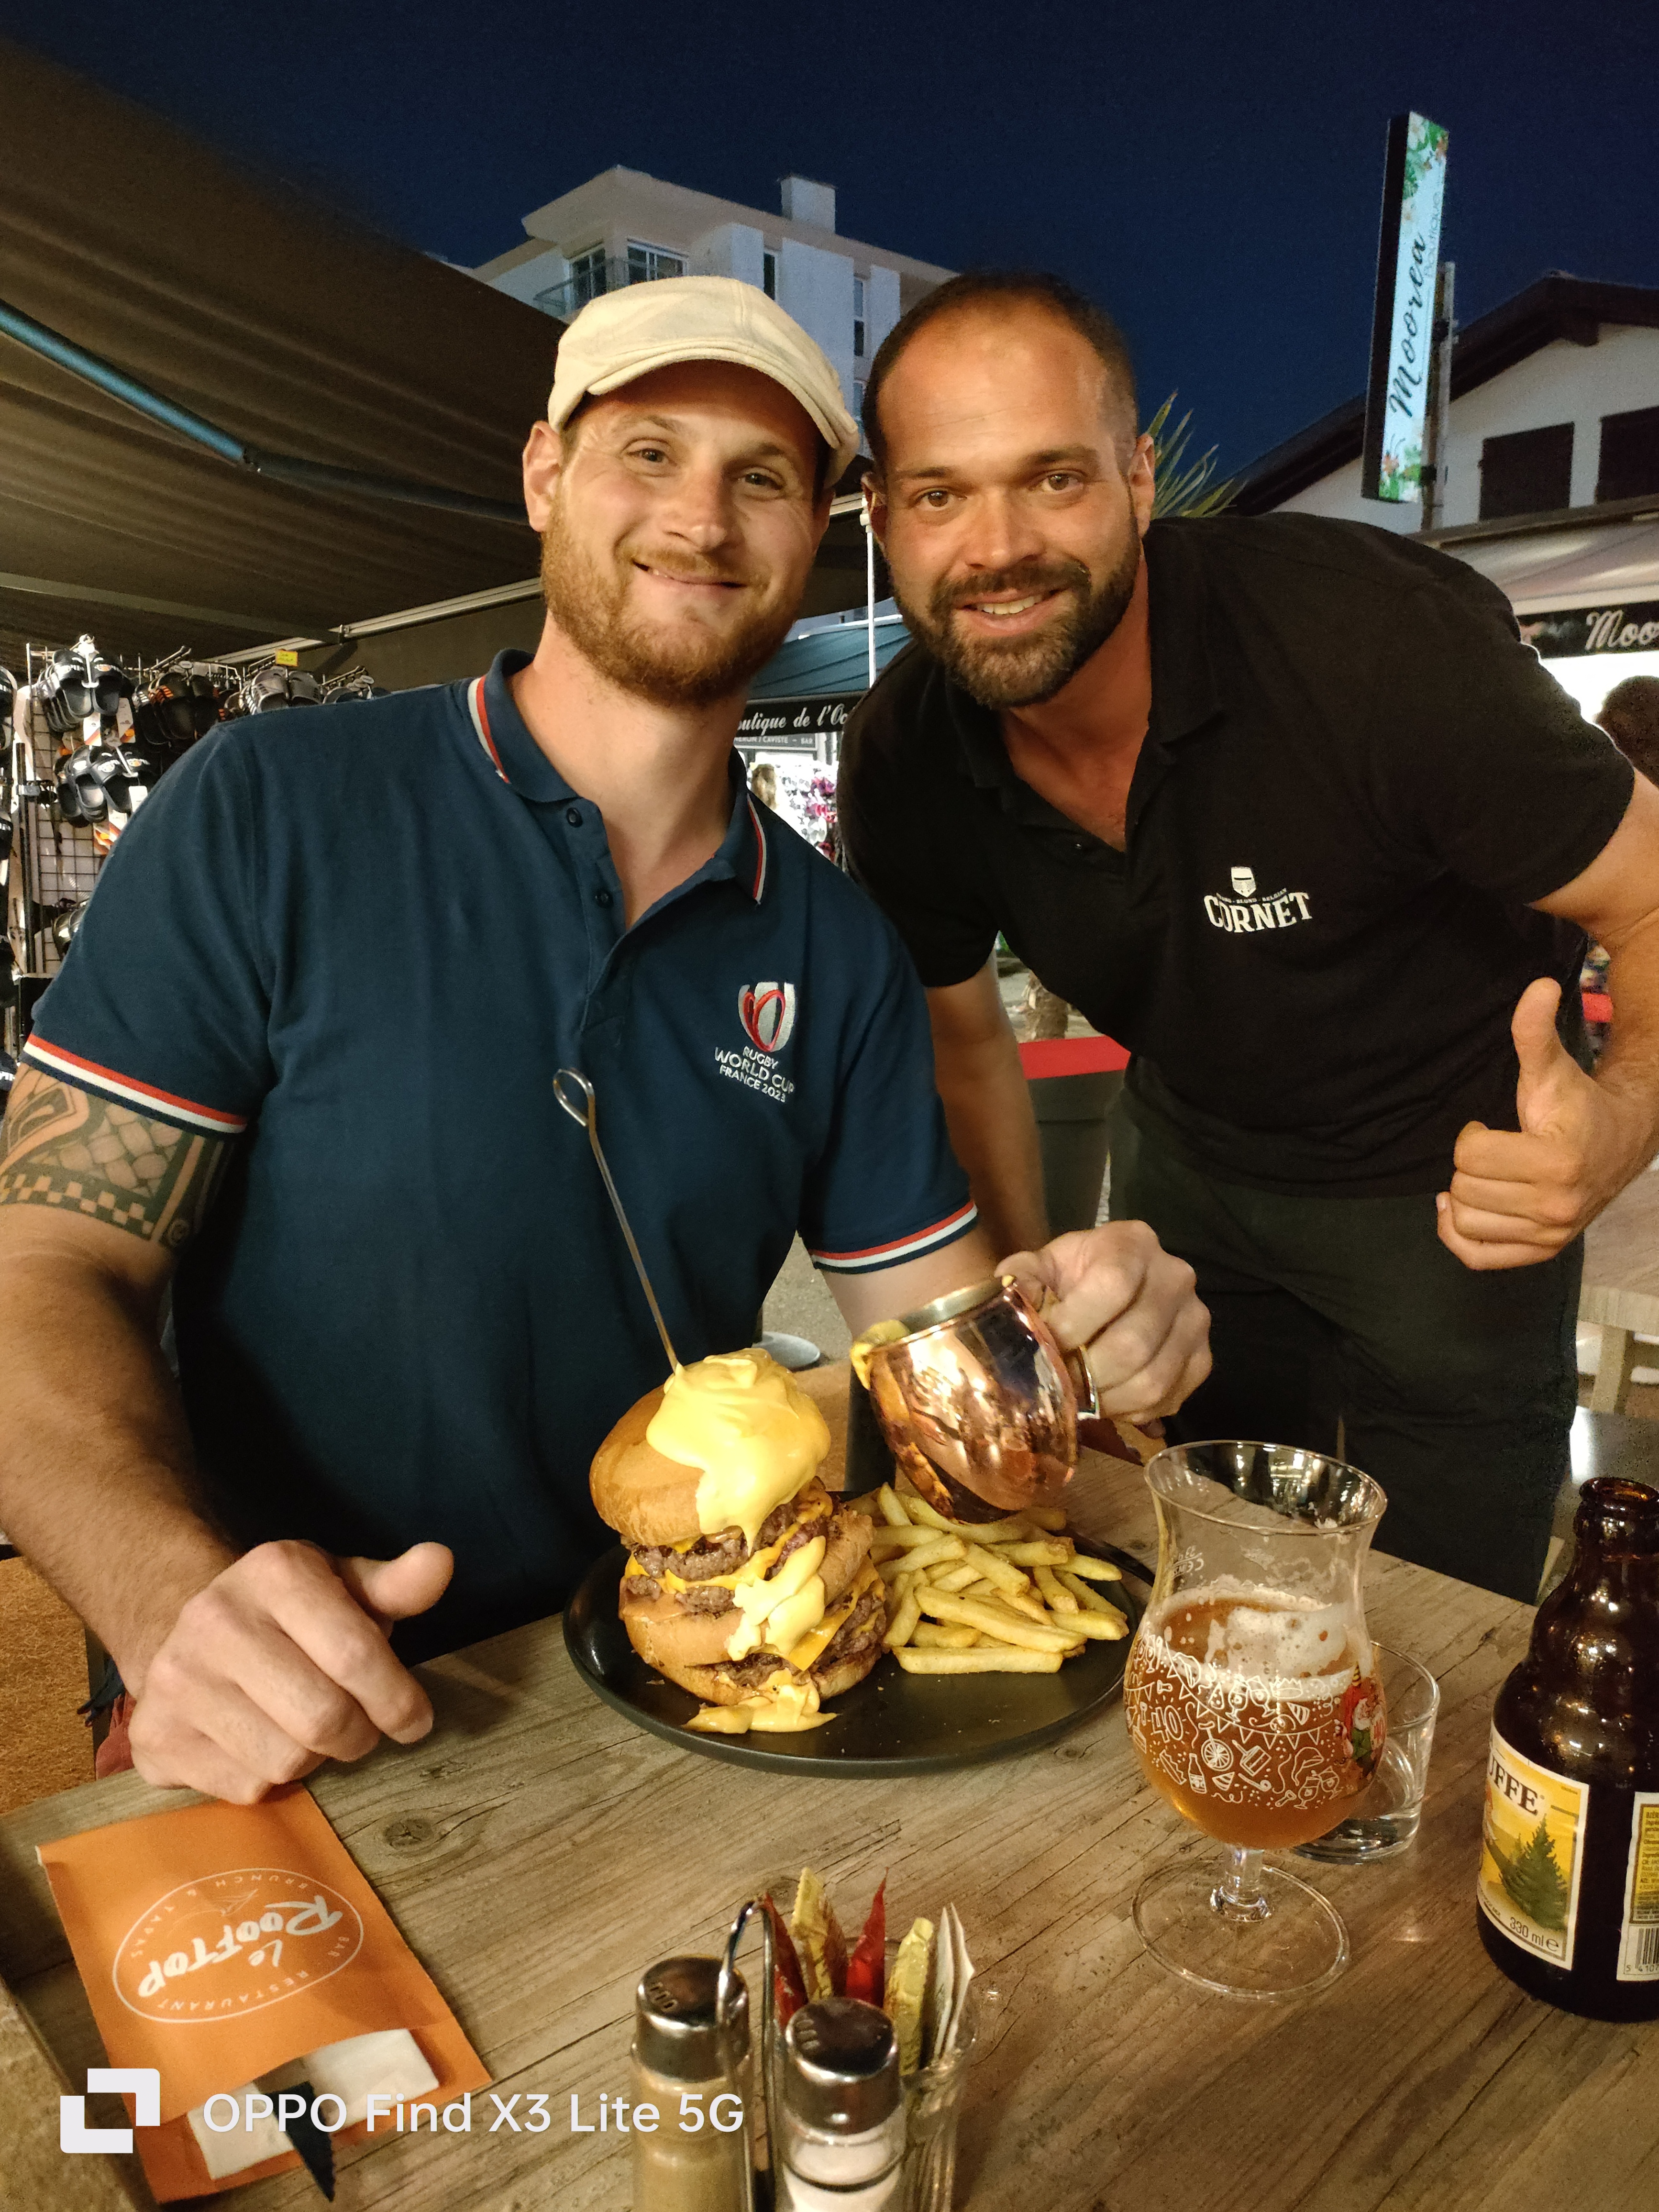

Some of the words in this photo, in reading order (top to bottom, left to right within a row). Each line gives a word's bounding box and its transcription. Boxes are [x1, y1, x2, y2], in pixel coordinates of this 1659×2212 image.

[1388, 234, 1427, 418] Moorea
[793, 707, 811, 728] de
[1204, 891, 1313, 933] CORNET
[714, 1047, 770, 1081] WORLD
[772, 1074, 796, 1094] CUP
[742, 1045, 779, 1069] RUGBY
[719, 1064, 762, 1090] FRANCE
[761, 1083, 786, 1103] 2023
[1151, 1705, 1183, 1743] 40
[215, 1874, 308, 1890] BRUNCH
[131, 1906, 175, 1958] TAPAS
[1510, 1916, 1528, 1938] 330
[1532, 1933, 1544, 1947] ml
[157, 1970, 309, 2010] RESTAURANT
